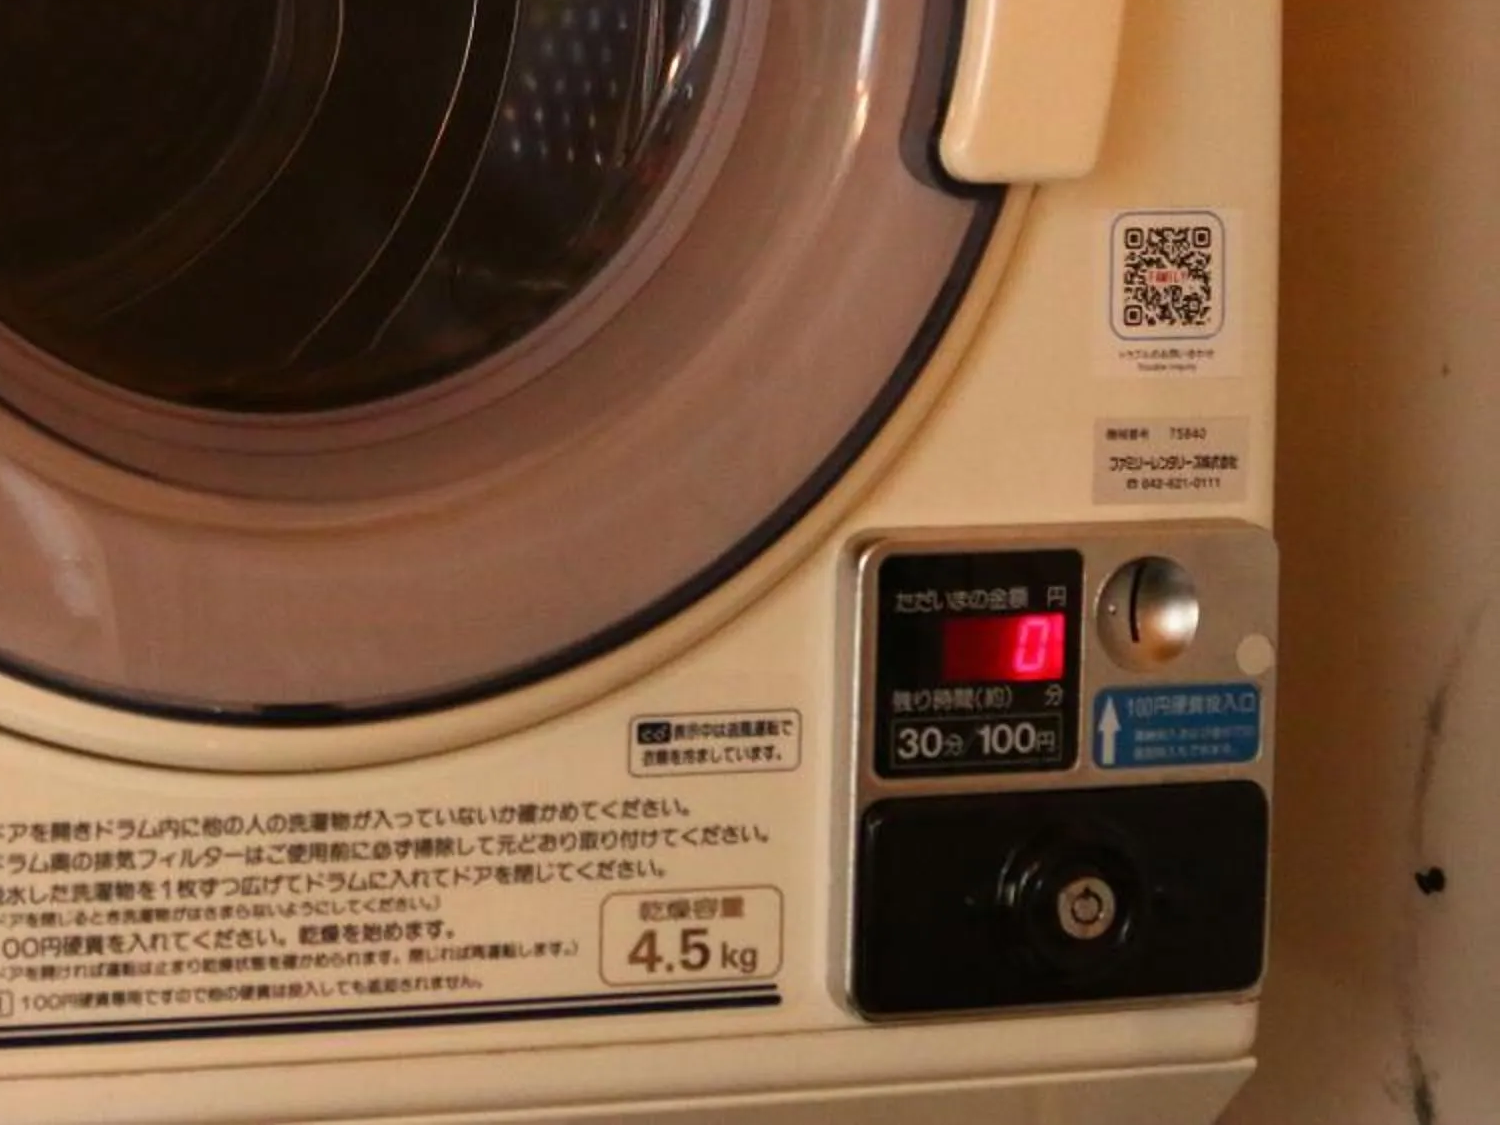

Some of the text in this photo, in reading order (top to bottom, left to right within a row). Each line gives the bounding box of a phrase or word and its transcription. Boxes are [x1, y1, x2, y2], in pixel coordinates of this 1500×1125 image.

[1046, 586, 1068, 608] 円
[1012, 614, 1052, 674] 0
[1043, 683, 1064, 707] 分
[638, 895, 746, 923] 乾燥容量
